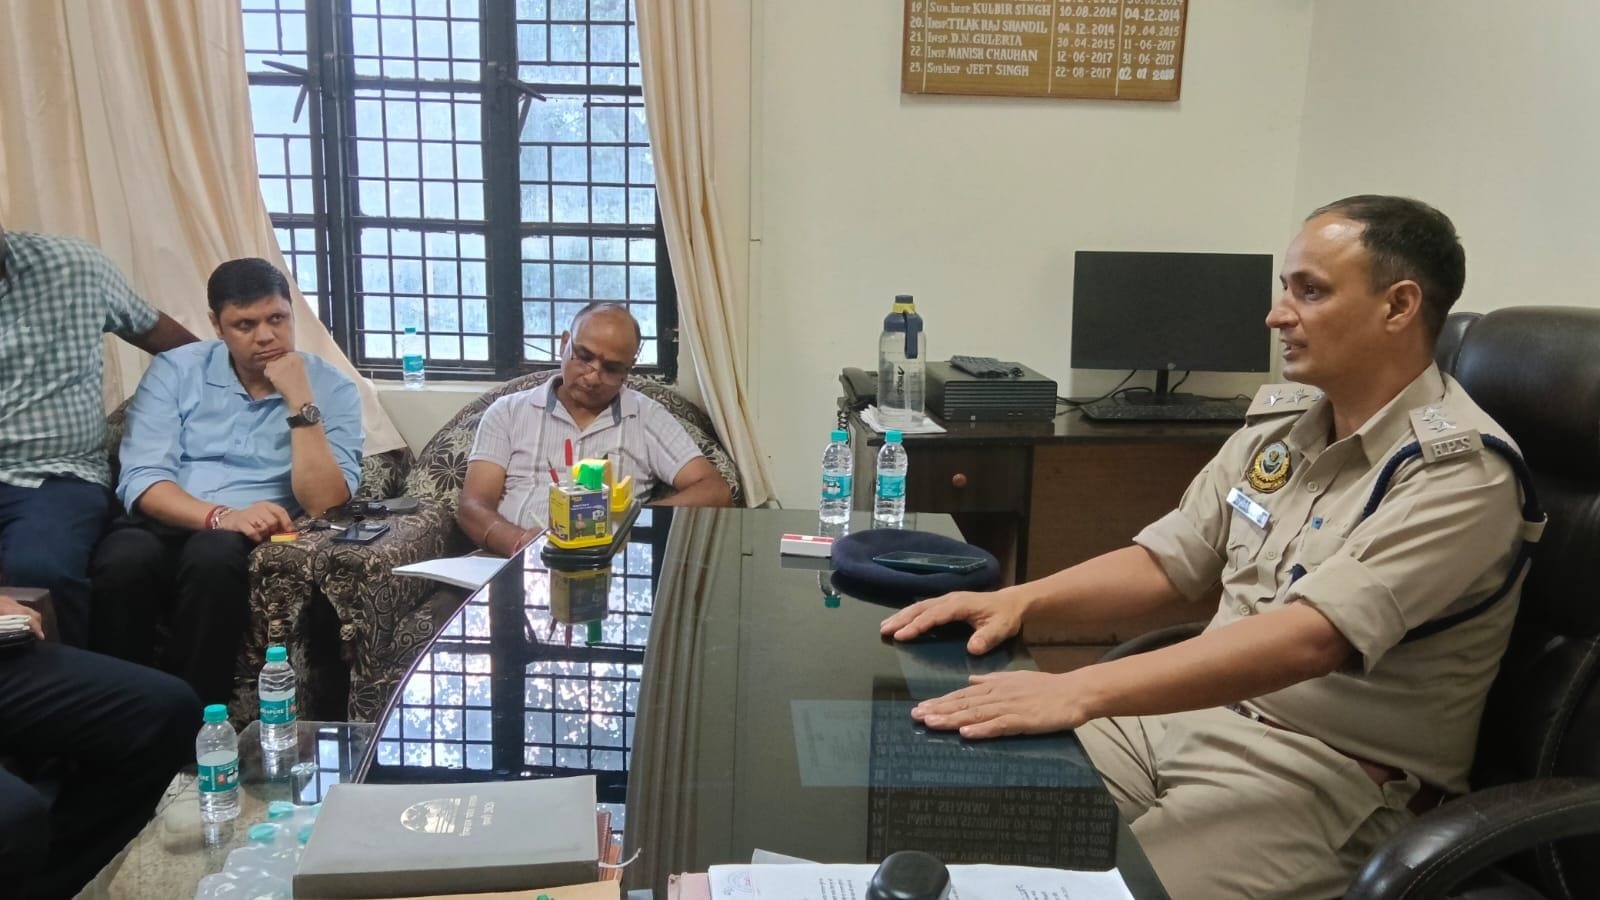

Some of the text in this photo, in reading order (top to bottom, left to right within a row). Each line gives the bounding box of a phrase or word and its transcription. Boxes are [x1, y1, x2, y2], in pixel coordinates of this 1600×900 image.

[972, 3, 1012, 15] KULBIR
[1015, 4, 1051, 16] SINGH
[1059, 6, 1117, 18] 10.08.2014
[1124, 8, 1180, 22] 04.12.2014
[946, 18, 981, 31] TILAK
[981, 19, 1000, 32] RAJ
[1003, 20, 1048, 33] SHANDIL
[1057, 22, 1115, 36] 04.12.2014
[1123, 25, 1180, 37] 29.04.2015
[972, 34, 1023, 46] GULERIA
[1057, 37, 1115, 49] 30.04.2015
[1124, 39, 1176, 51] 11-06-2017
[948, 47, 984, 60] MANISH
[986, 48, 1038, 61] CHAUHAN
[1057, 50, 1113, 63] 12-06-2017
[1122, 52, 1175, 65] 31-06-2017
[966, 63, 993, 75] JEET
[995, 64, 1029, 77] SINGH
[1055, 66, 1112, 79] 22-08-2017
